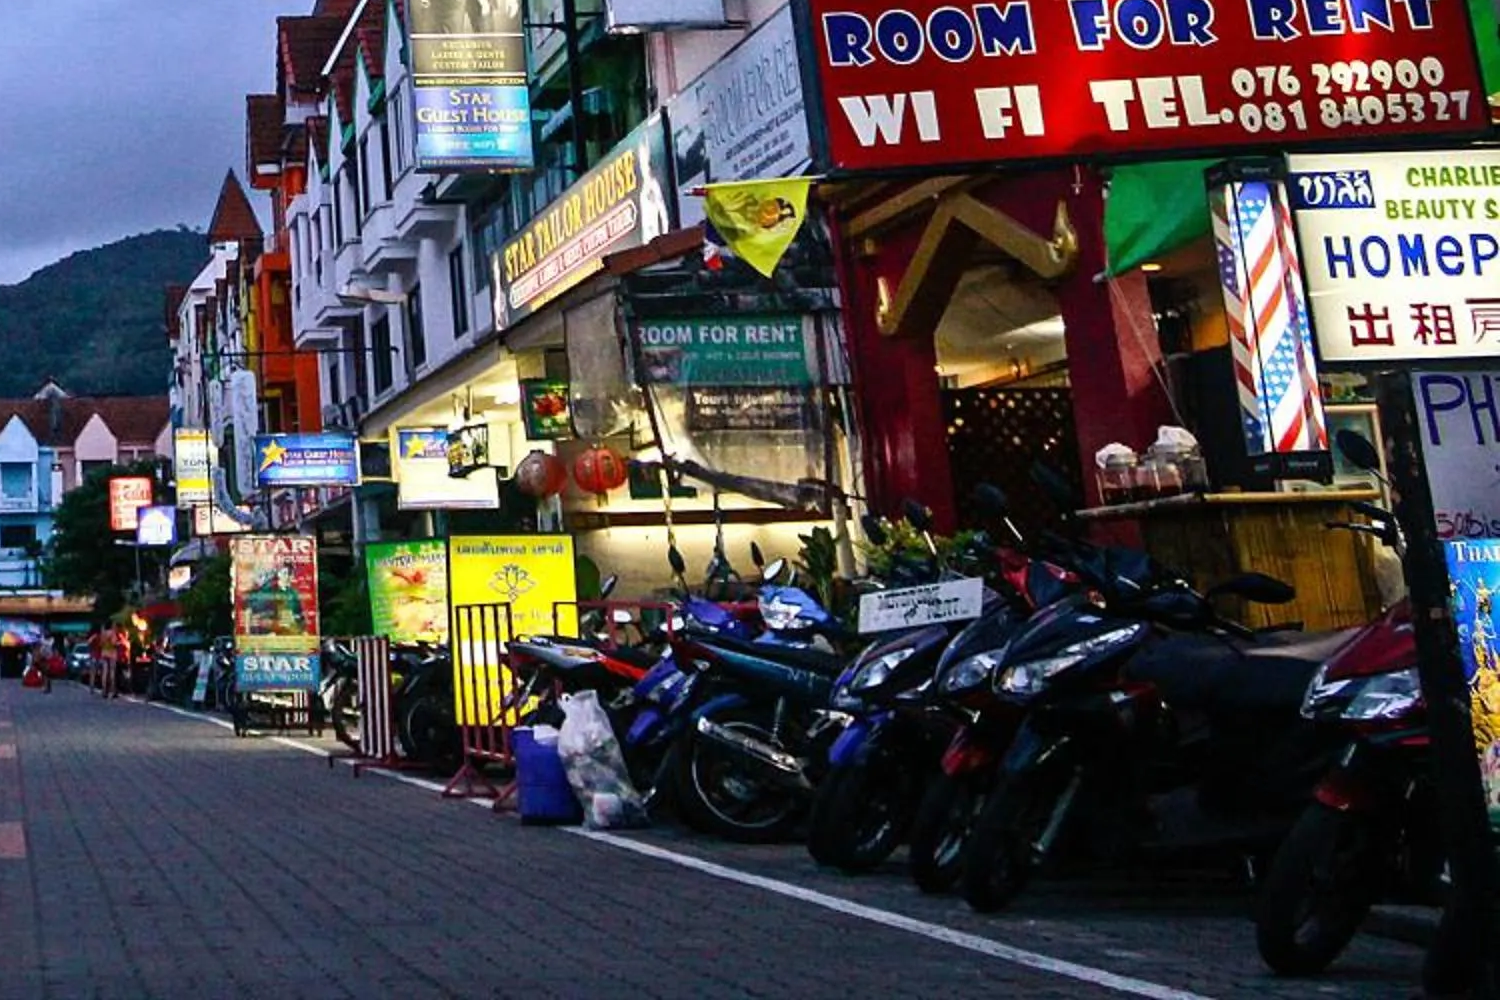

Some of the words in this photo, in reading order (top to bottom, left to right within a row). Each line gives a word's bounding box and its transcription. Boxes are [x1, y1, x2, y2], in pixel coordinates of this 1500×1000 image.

[820, 1, 1038, 68] ROOM
[838, 91, 942, 147] WI
[974, 84, 1045, 140] FI
[1231, 65, 1300, 98] 076
[1311, 56, 1446, 97] 292900
[1239, 100, 1308, 135] 081
[504, 238, 537, 282] STAR
[535, 194, 583, 259] TAILOR
[582, 150, 637, 223] HOUSE
[1385, 199, 1475, 220] BEAUTY
[700, 325, 738, 344] FOR
[746, 324, 799, 344] RENT
[239, 539, 311, 554] STAR
[243, 657, 312, 672] STAR
